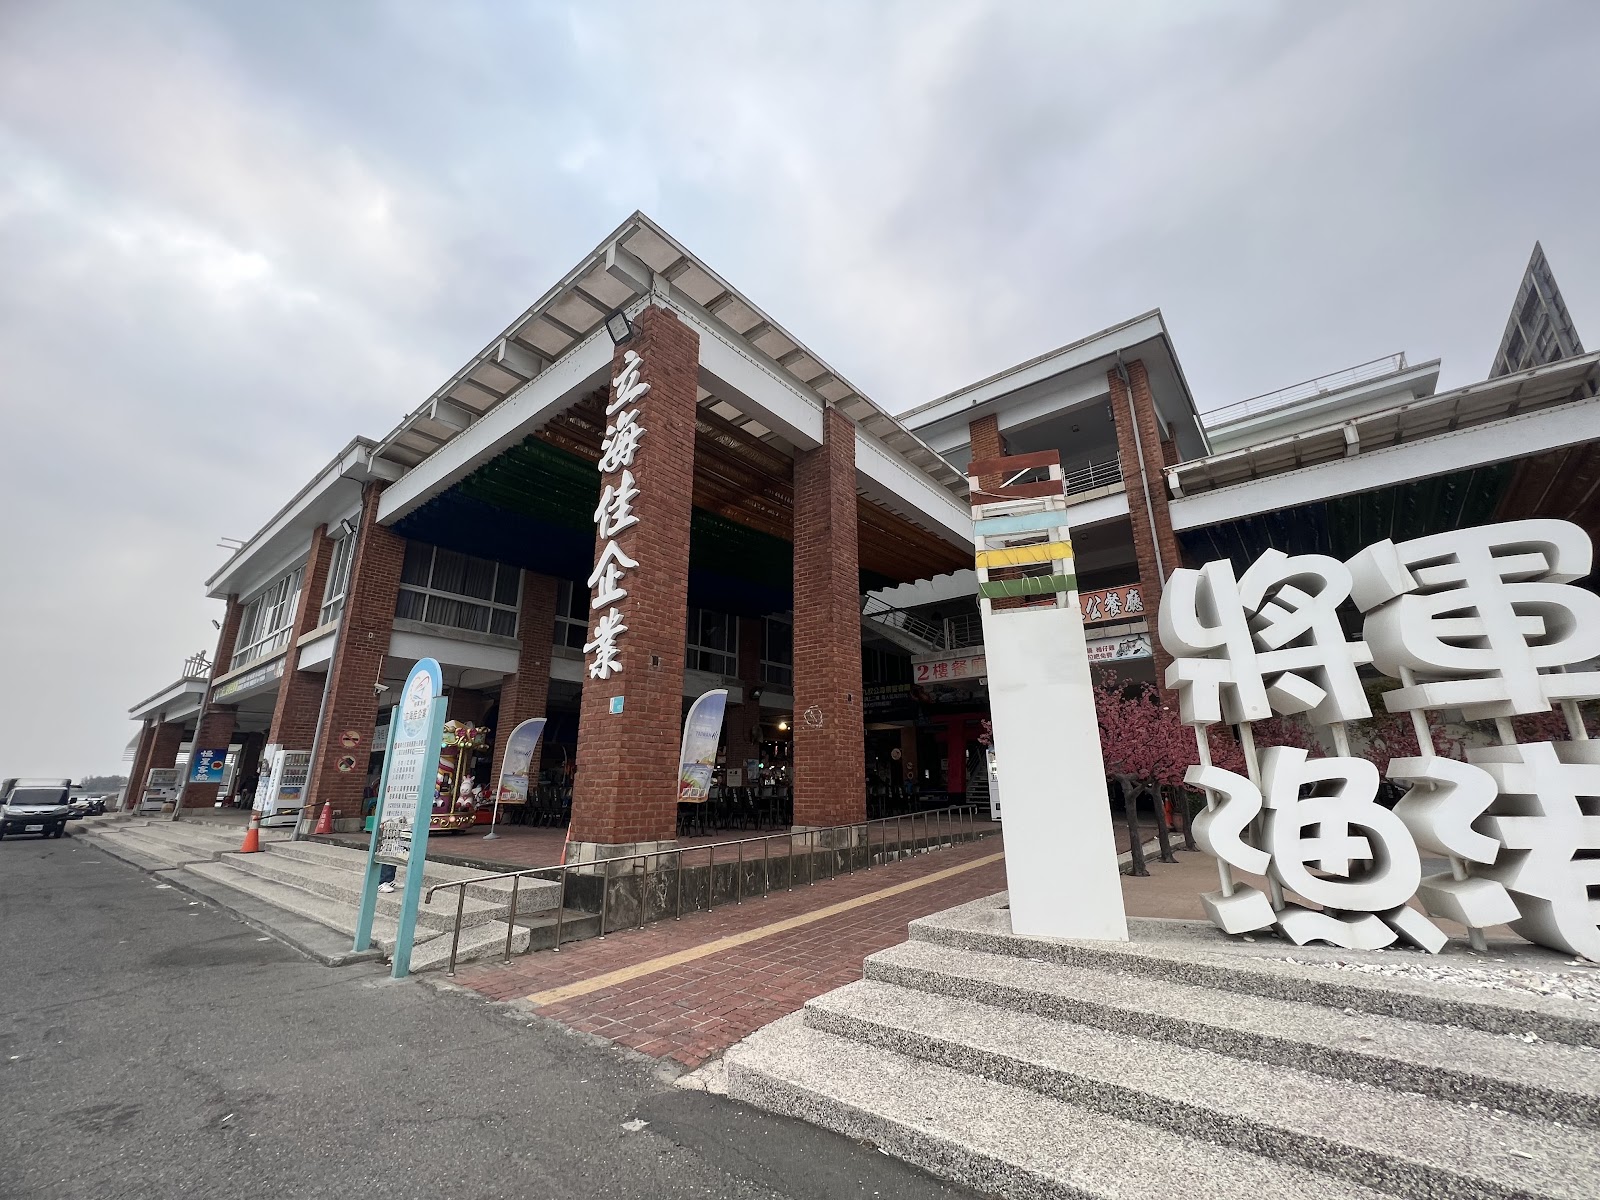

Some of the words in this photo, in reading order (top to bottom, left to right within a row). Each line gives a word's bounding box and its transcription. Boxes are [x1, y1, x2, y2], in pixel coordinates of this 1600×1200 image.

[583, 349, 651, 680] 立海佳企業
[1081, 588, 1144, 620] 公餐廳
[1158, 517, 1600, 727] 將軍
